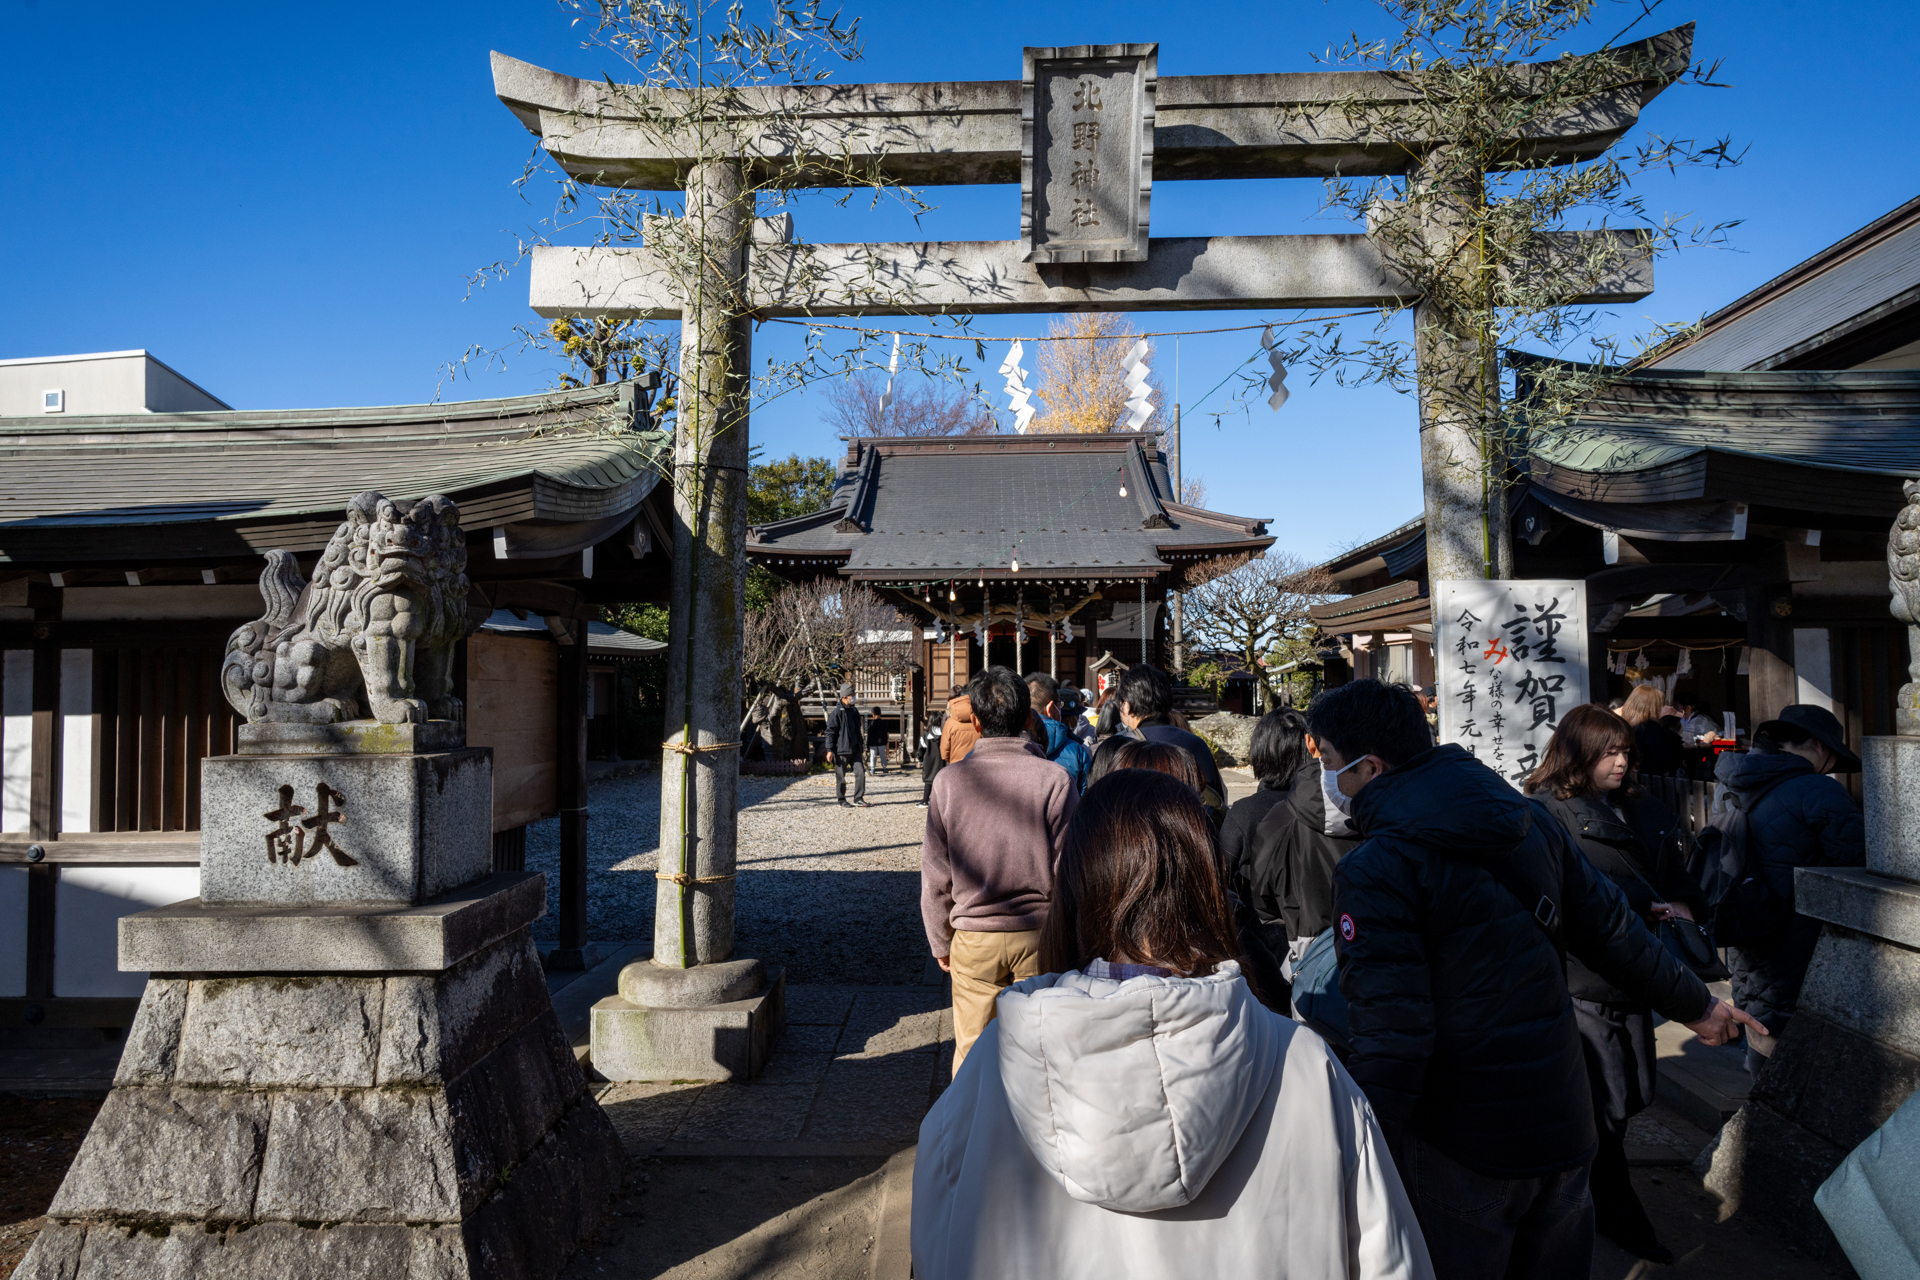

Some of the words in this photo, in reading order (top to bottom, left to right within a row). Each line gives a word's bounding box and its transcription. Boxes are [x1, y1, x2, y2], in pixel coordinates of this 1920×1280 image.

[1070, 80, 1104, 229] 北野神社
[263, 782, 359, 867] 献
